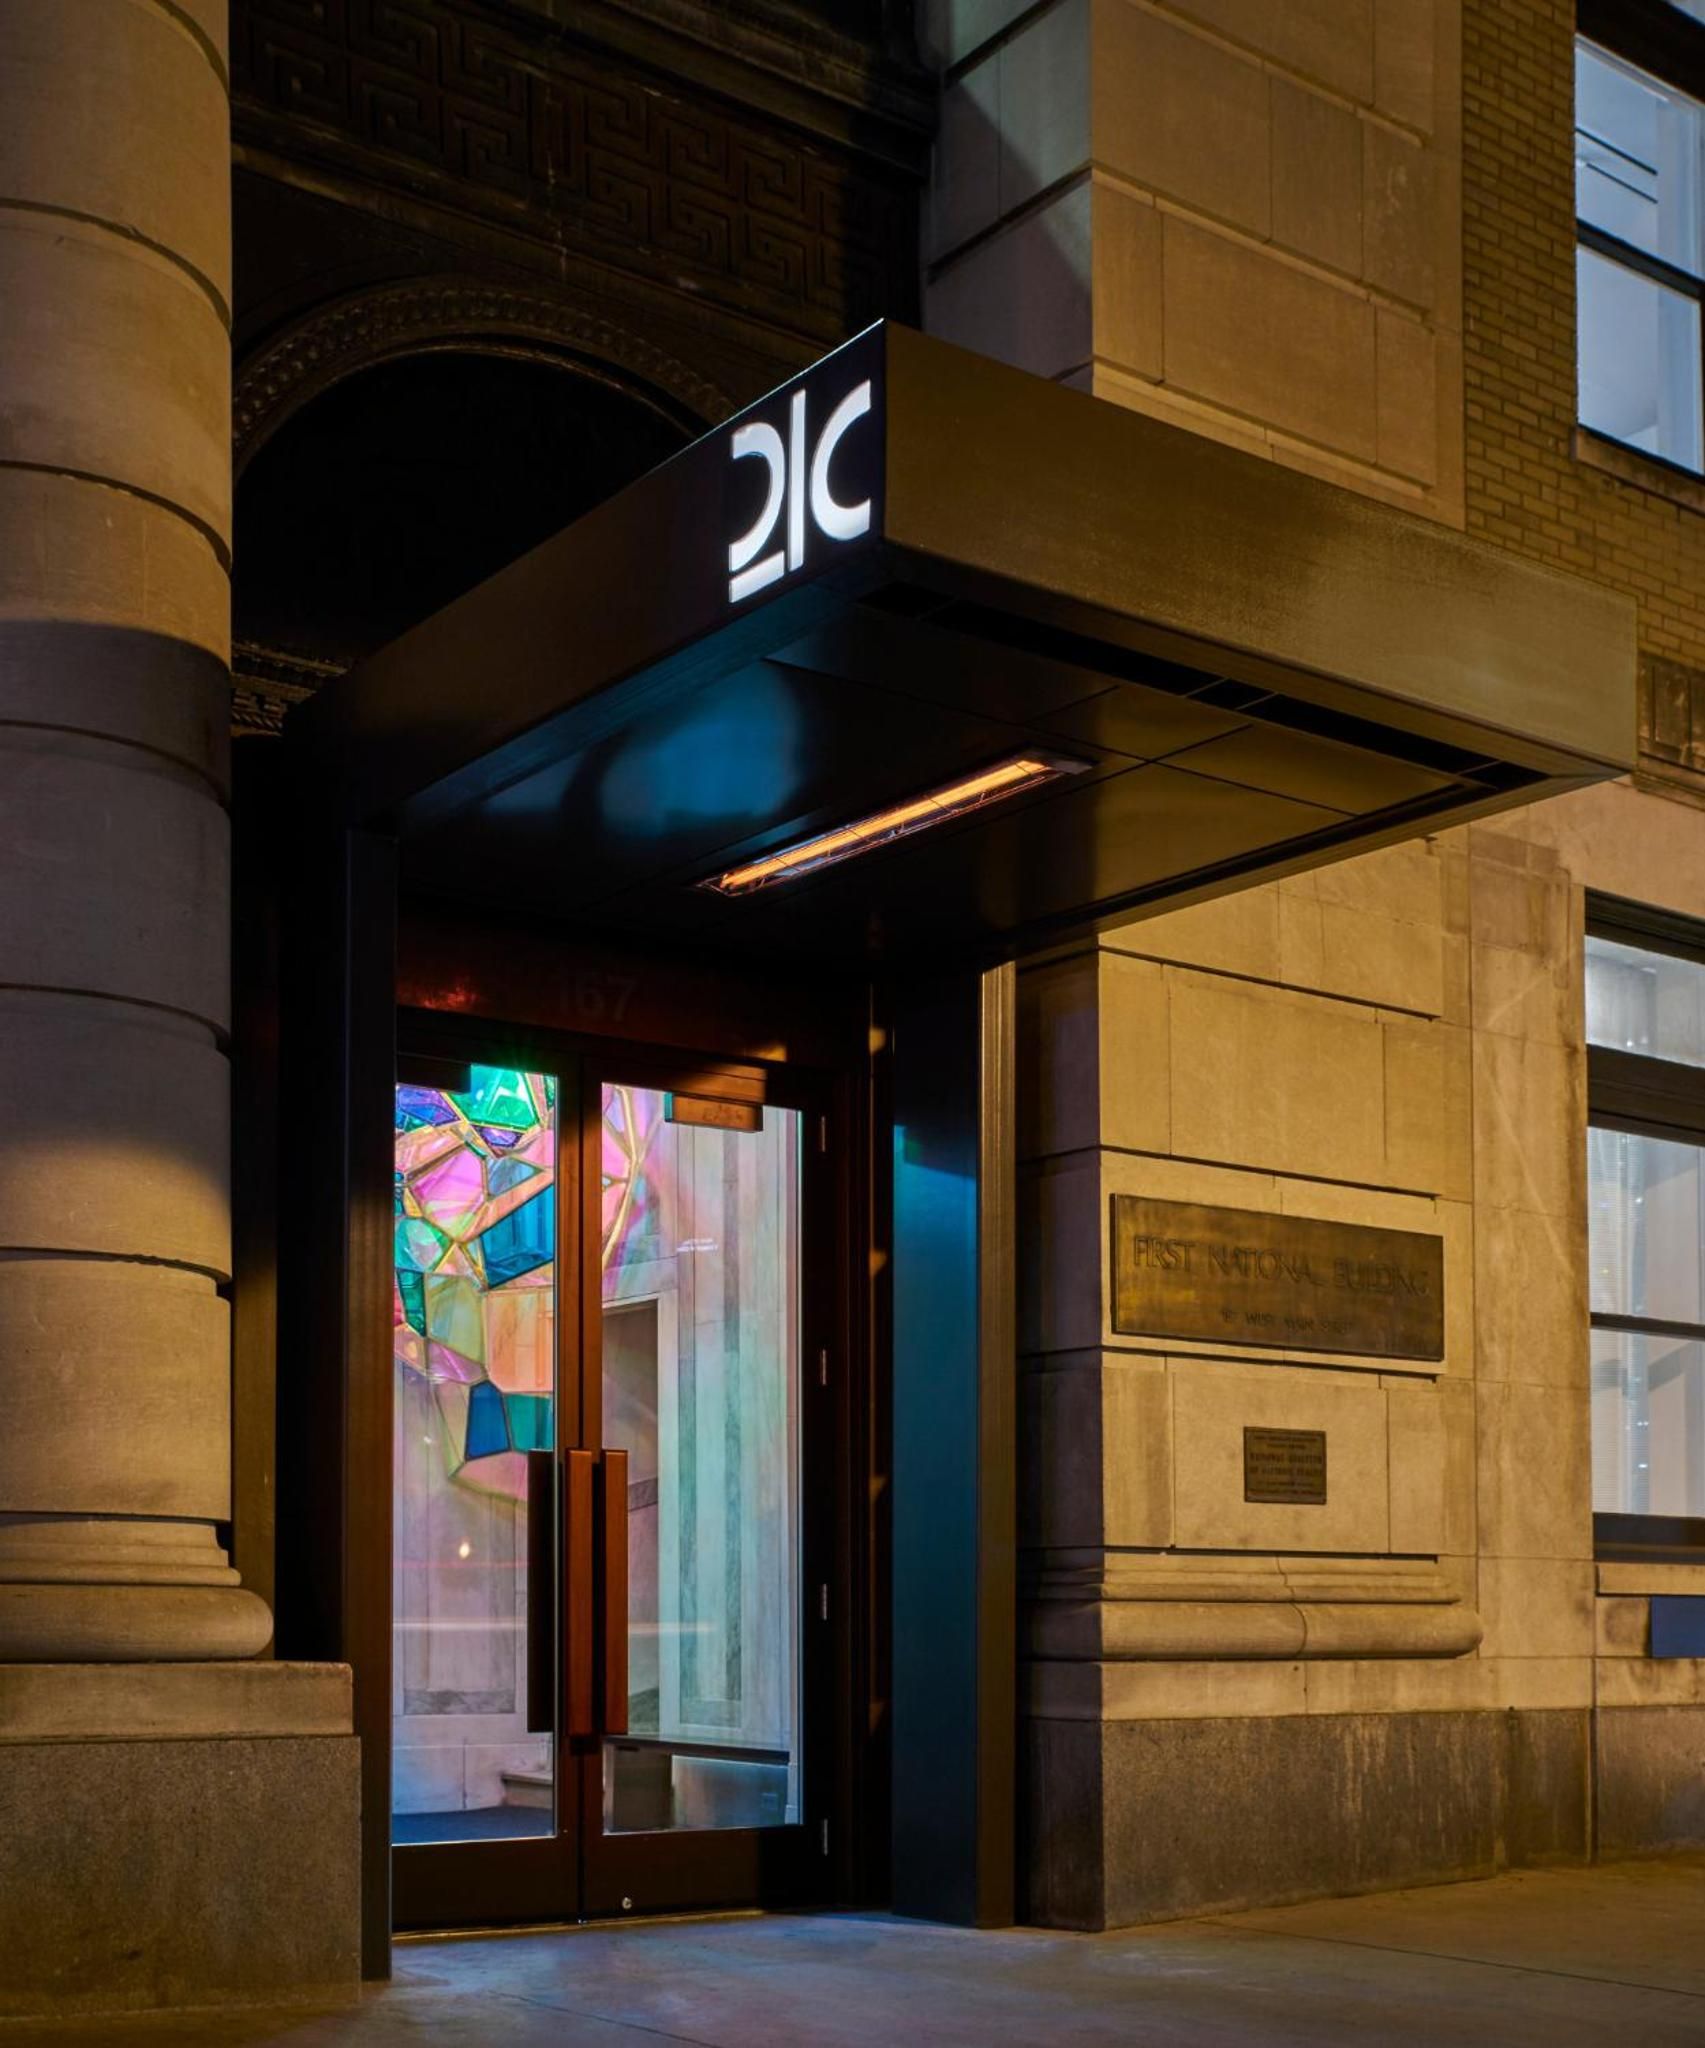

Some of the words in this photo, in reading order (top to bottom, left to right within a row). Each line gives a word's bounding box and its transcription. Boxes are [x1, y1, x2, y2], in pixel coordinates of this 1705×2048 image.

[1132, 1235, 1196, 1273] FIRST
[1207, 1244, 1325, 1287] NATIONAL
[1333, 1256, 1429, 1297] BUILDING
